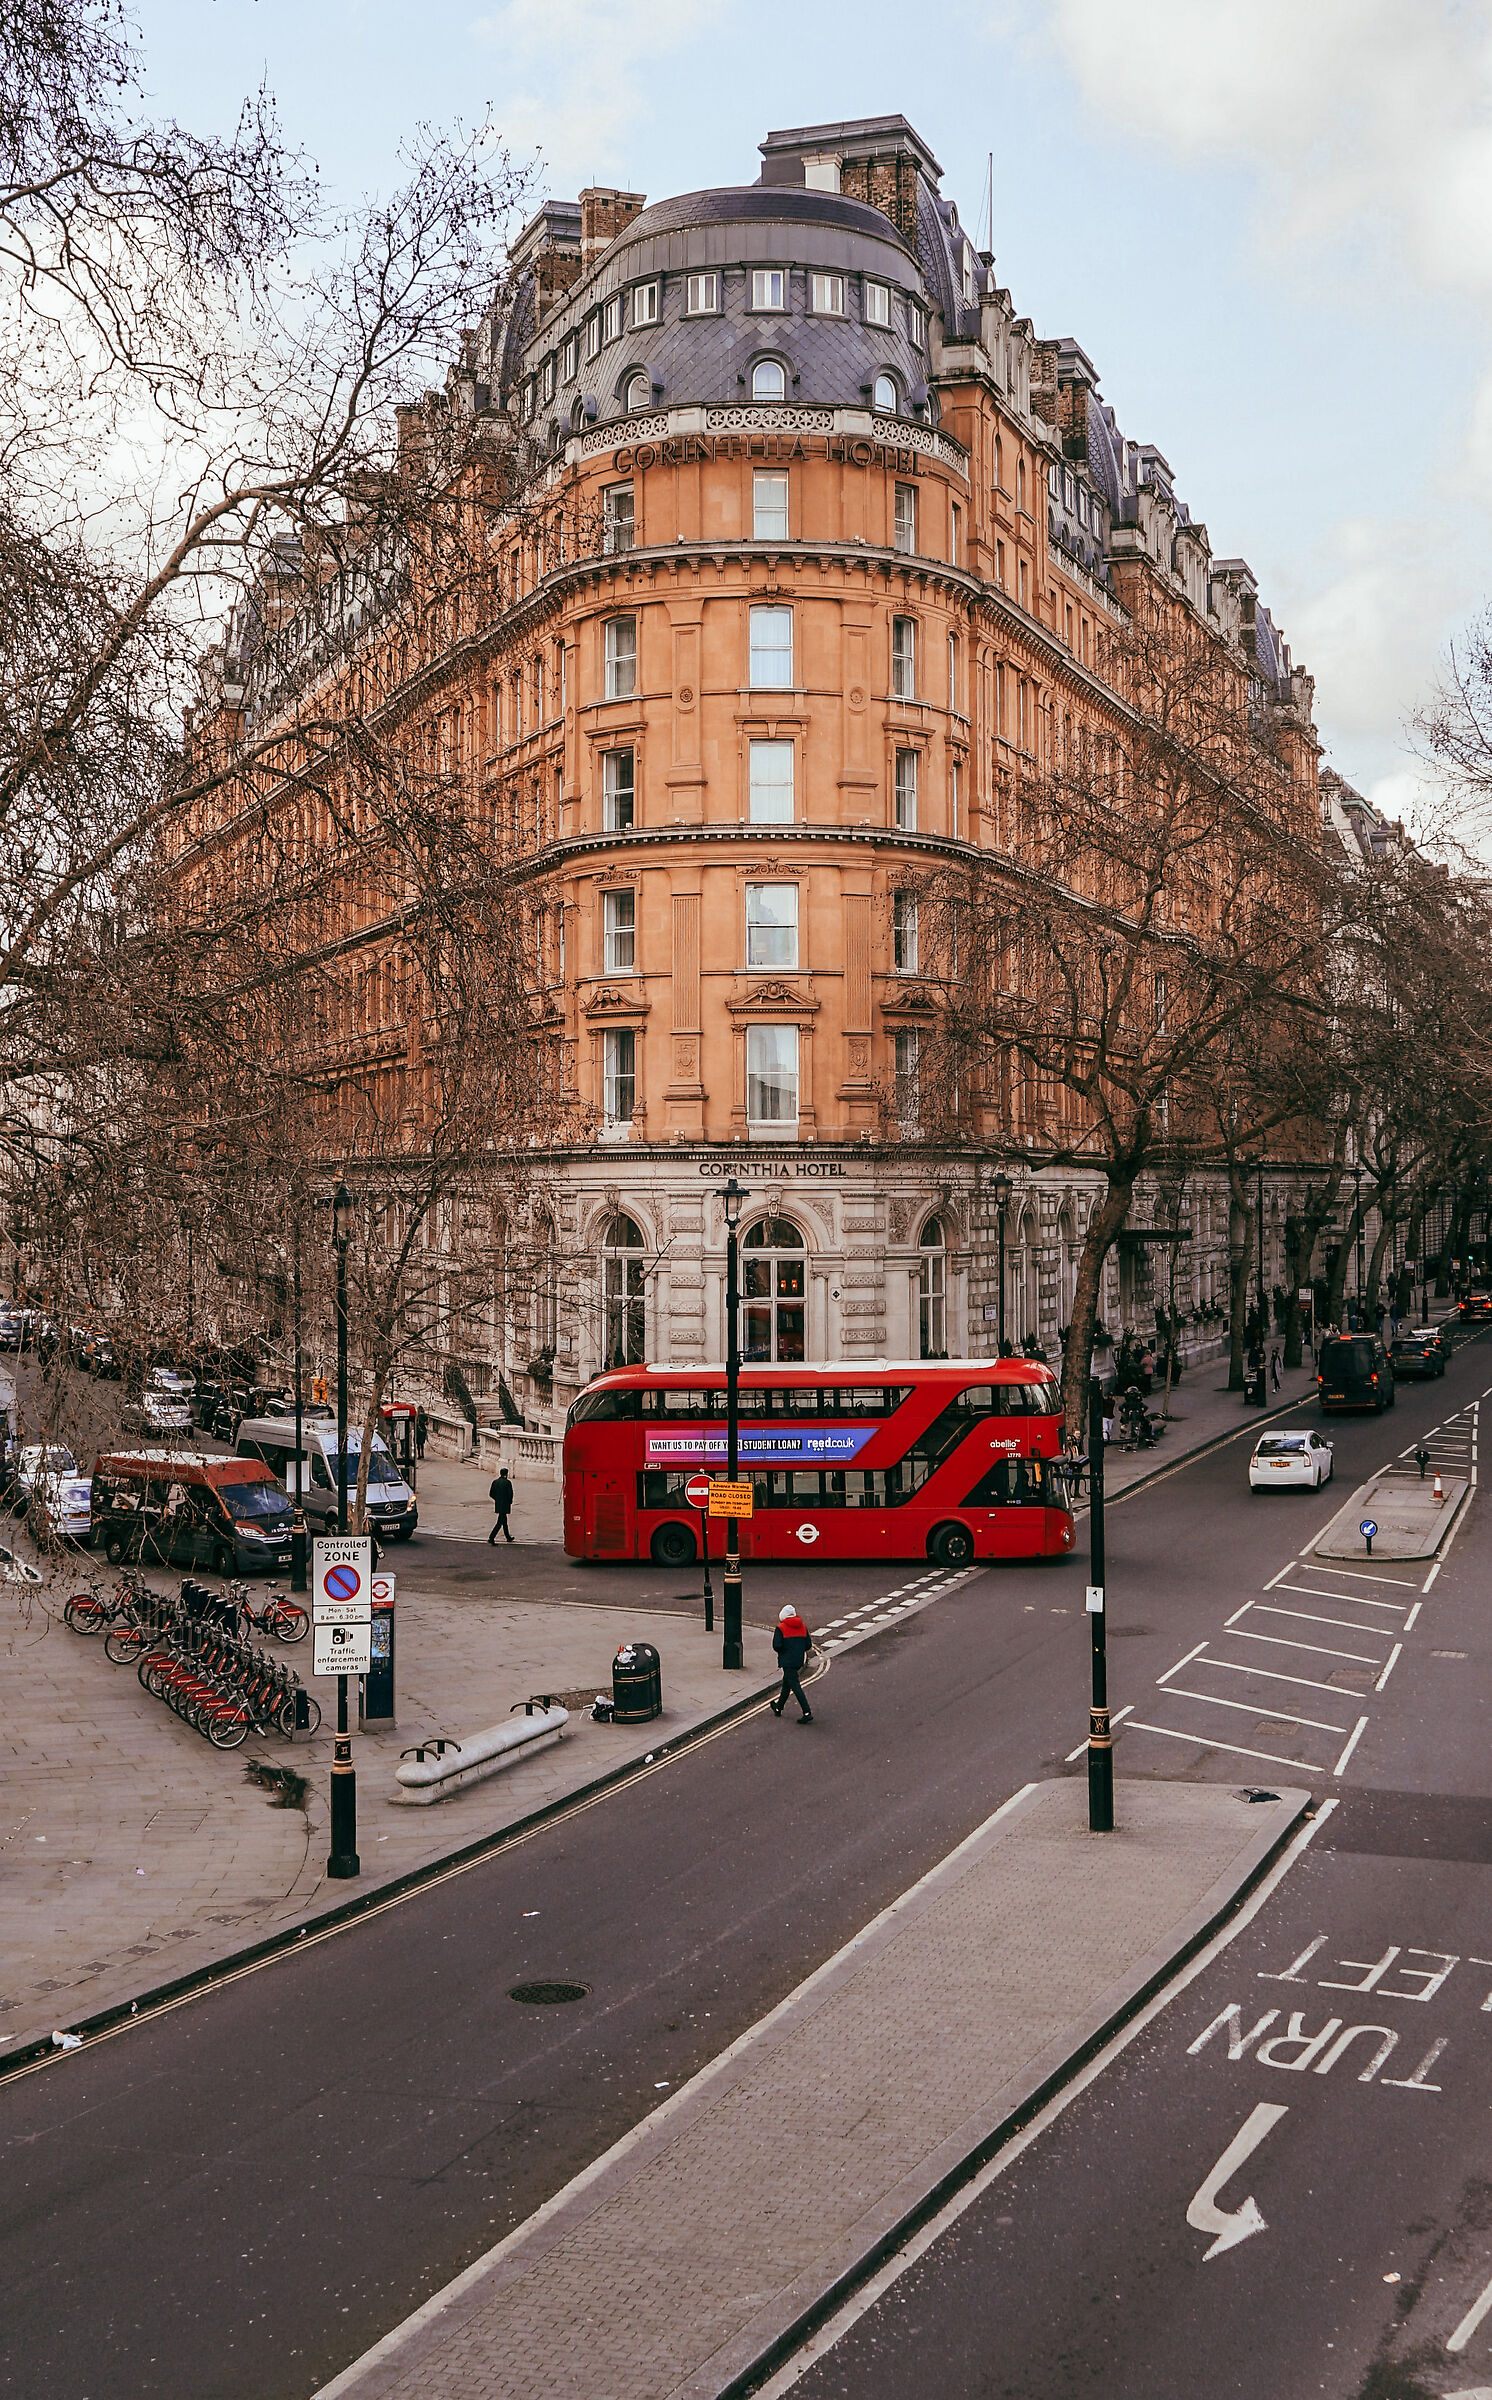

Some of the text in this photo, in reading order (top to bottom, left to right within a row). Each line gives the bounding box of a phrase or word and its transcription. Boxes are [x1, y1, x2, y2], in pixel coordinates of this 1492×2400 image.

[611, 435, 928, 477] CORINTHIA HOTEL
[795, 1163, 847, 1176] HOTEL
[673, 1440, 682, 1450] US
[684, 1440, 693, 1450] TO
[694, 1440, 707, 1450] PAY
[708, 1440, 721, 1450] OFF
[743, 1440, 776, 1450] STUDENT
[777, 1440, 801, 1450] LOAN?
[316, 1540, 368, 1549] Controlled
[324, 1551, 360, 1561] ZONE
[330, 1647, 356, 1655] Traffic
[317, 1655, 368, 1664] enforcement
[1186, 2003, 1449, 2092] TURN
